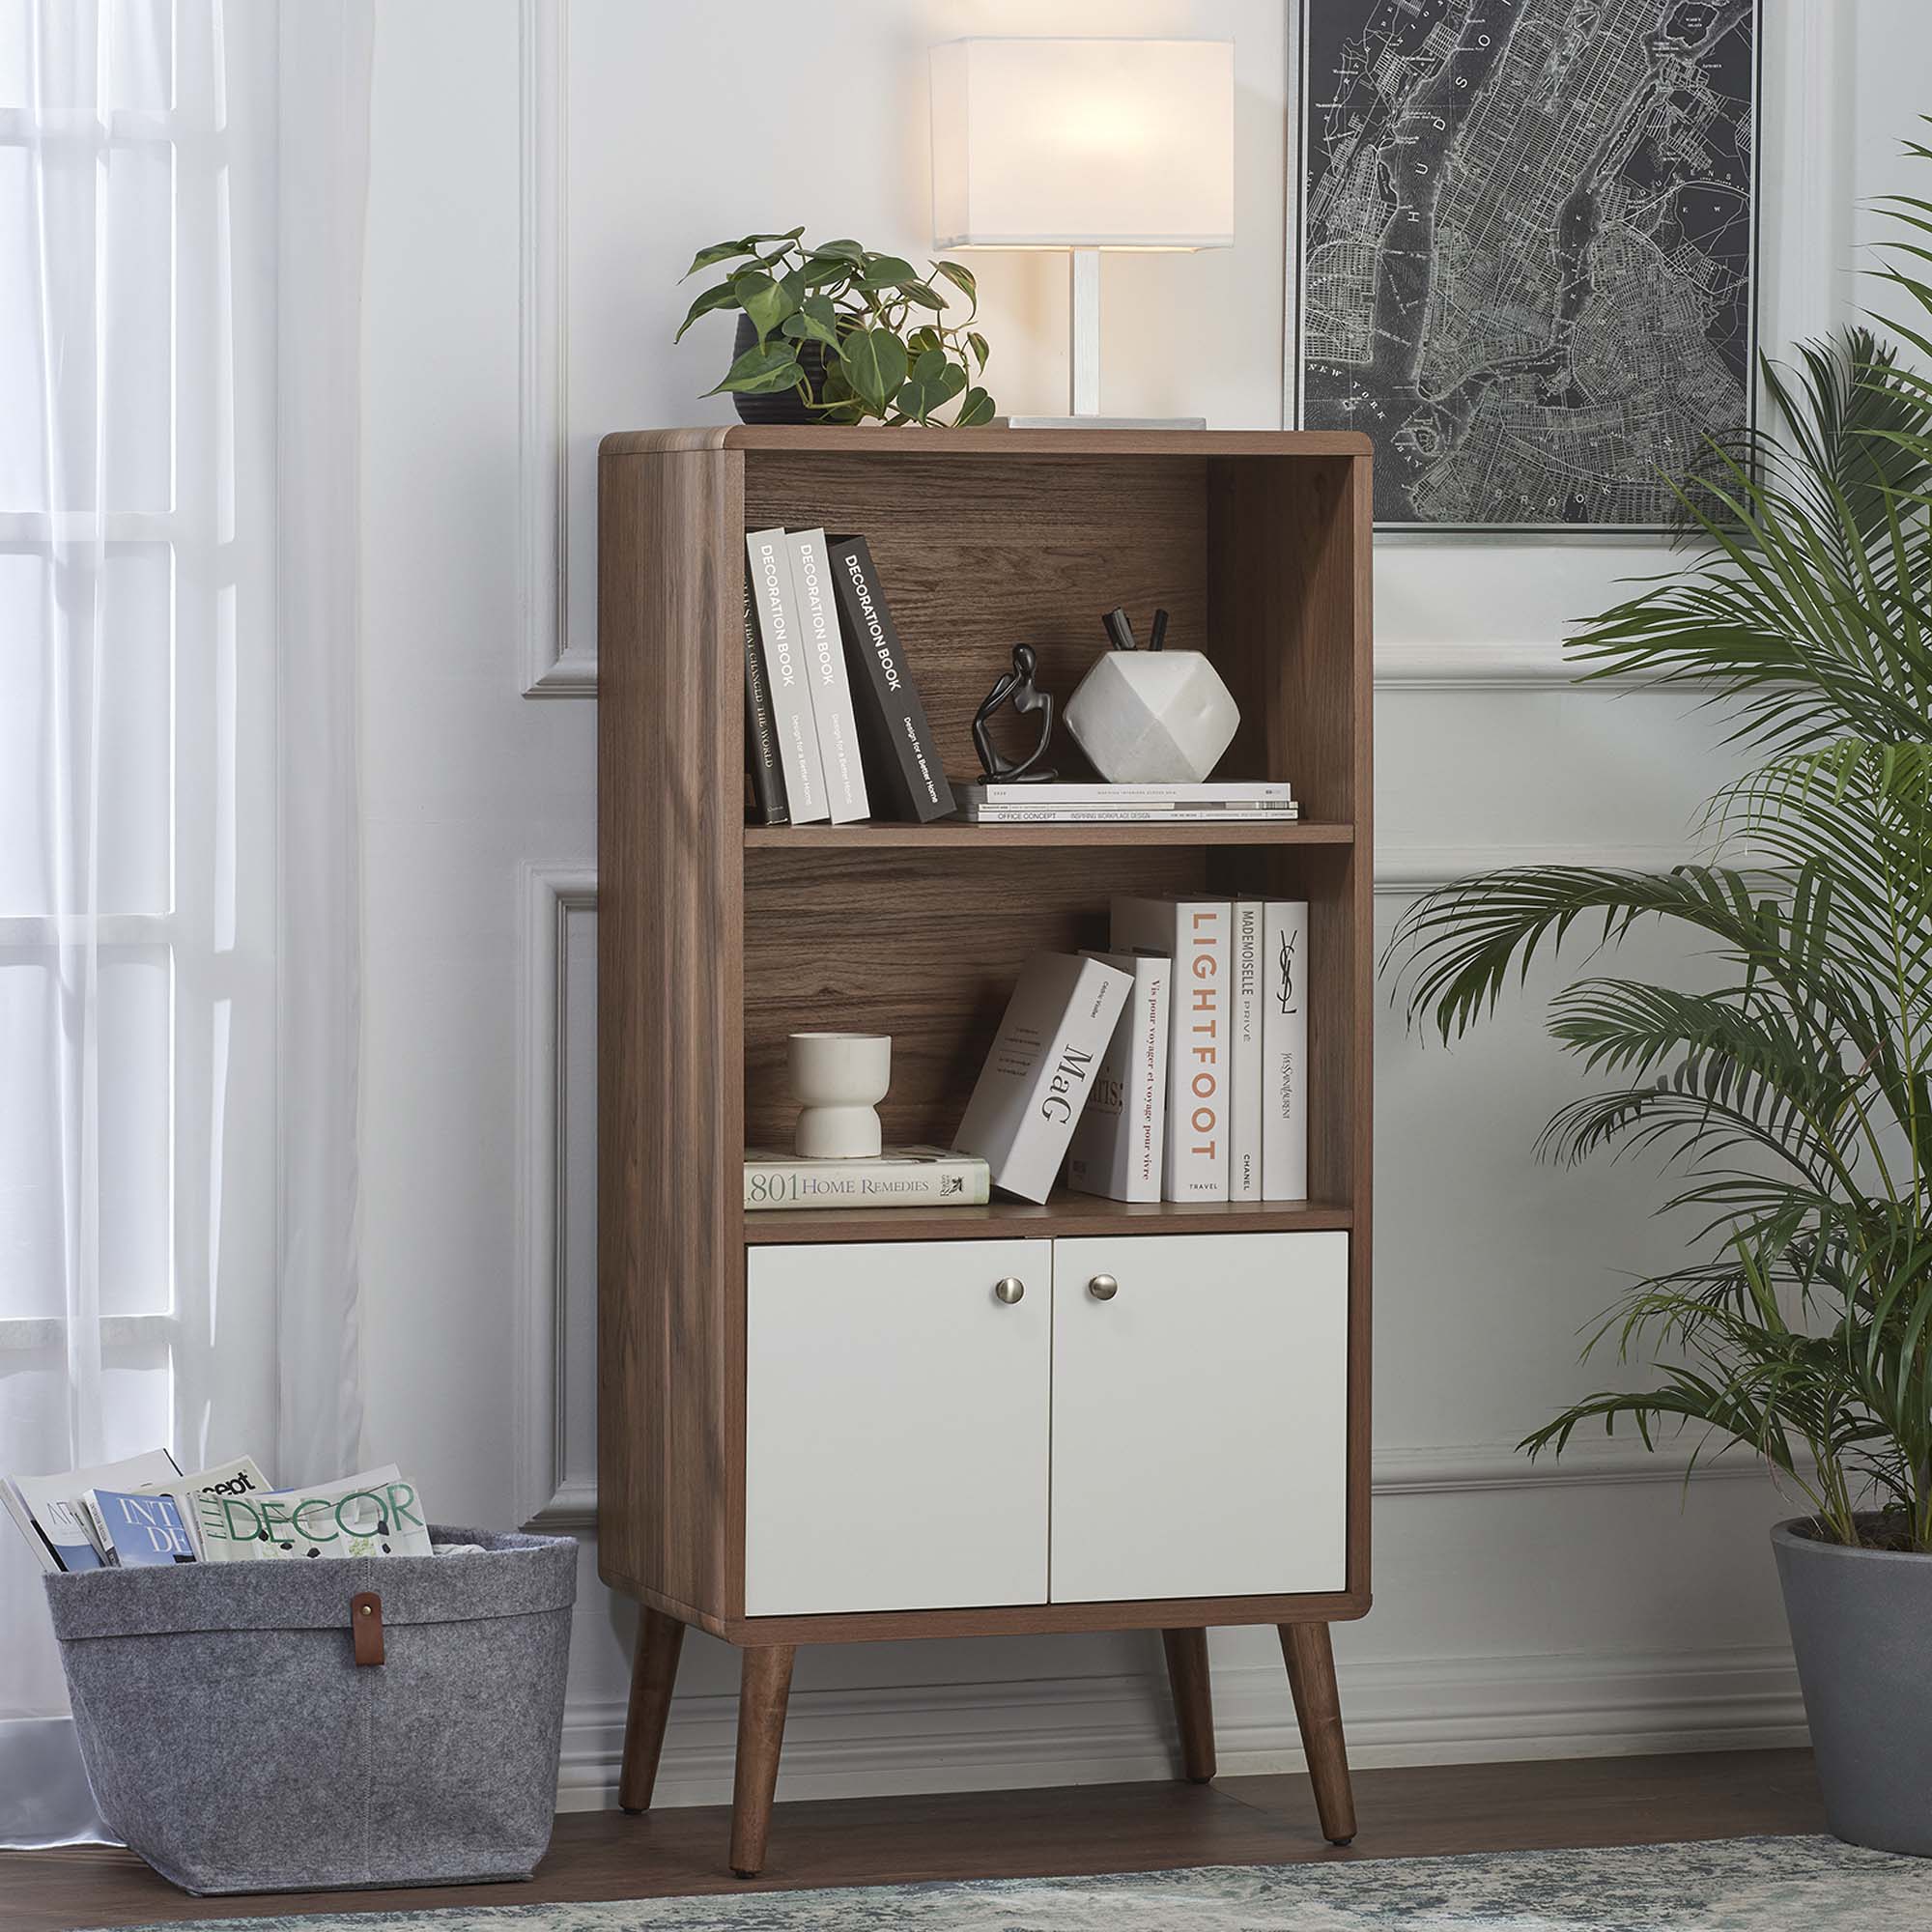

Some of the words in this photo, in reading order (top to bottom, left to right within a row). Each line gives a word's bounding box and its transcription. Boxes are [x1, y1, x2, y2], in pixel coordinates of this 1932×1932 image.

[1307, 363, 1343, 377] NEW
[1352, 381, 1387, 421] YORK
[761, 545, 786, 639] DECORATION
[778, 643, 795, 687] BOOK
[801, 544, 826, 639] DECORATION
[817, 642, 835, 685] BOOK
[845, 554, 886, 647] DECORATION
[877, 648, 901, 692] BOOK
[904, 717, 917, 742] Design
[918, 758, 930, 781] Better
[926, 781, 938, 803] Home
[1241, 911, 1255, 996] MADEMOISELLE
[1148, 999, 1157, 1024] pour
[1151, 980, 1161, 995] Vis
[1145, 1028, 1155, 1067] voyager
[1191, 913, 1217, 1159] LIGHTFOOT
[1041, 1043, 1094, 1124] MaG
[1144, 1085, 1153, 1122] voyage
[1147, 1071, 1154, 1082] et
[1143, 1124, 1151, 1151] pour
[802, 1179, 855, 1194] HOME
[863, 1179, 929, 1194] REMEDIES
[120, 1497, 177, 1527] INT
[223, 1484, 423, 1542] DECOR
